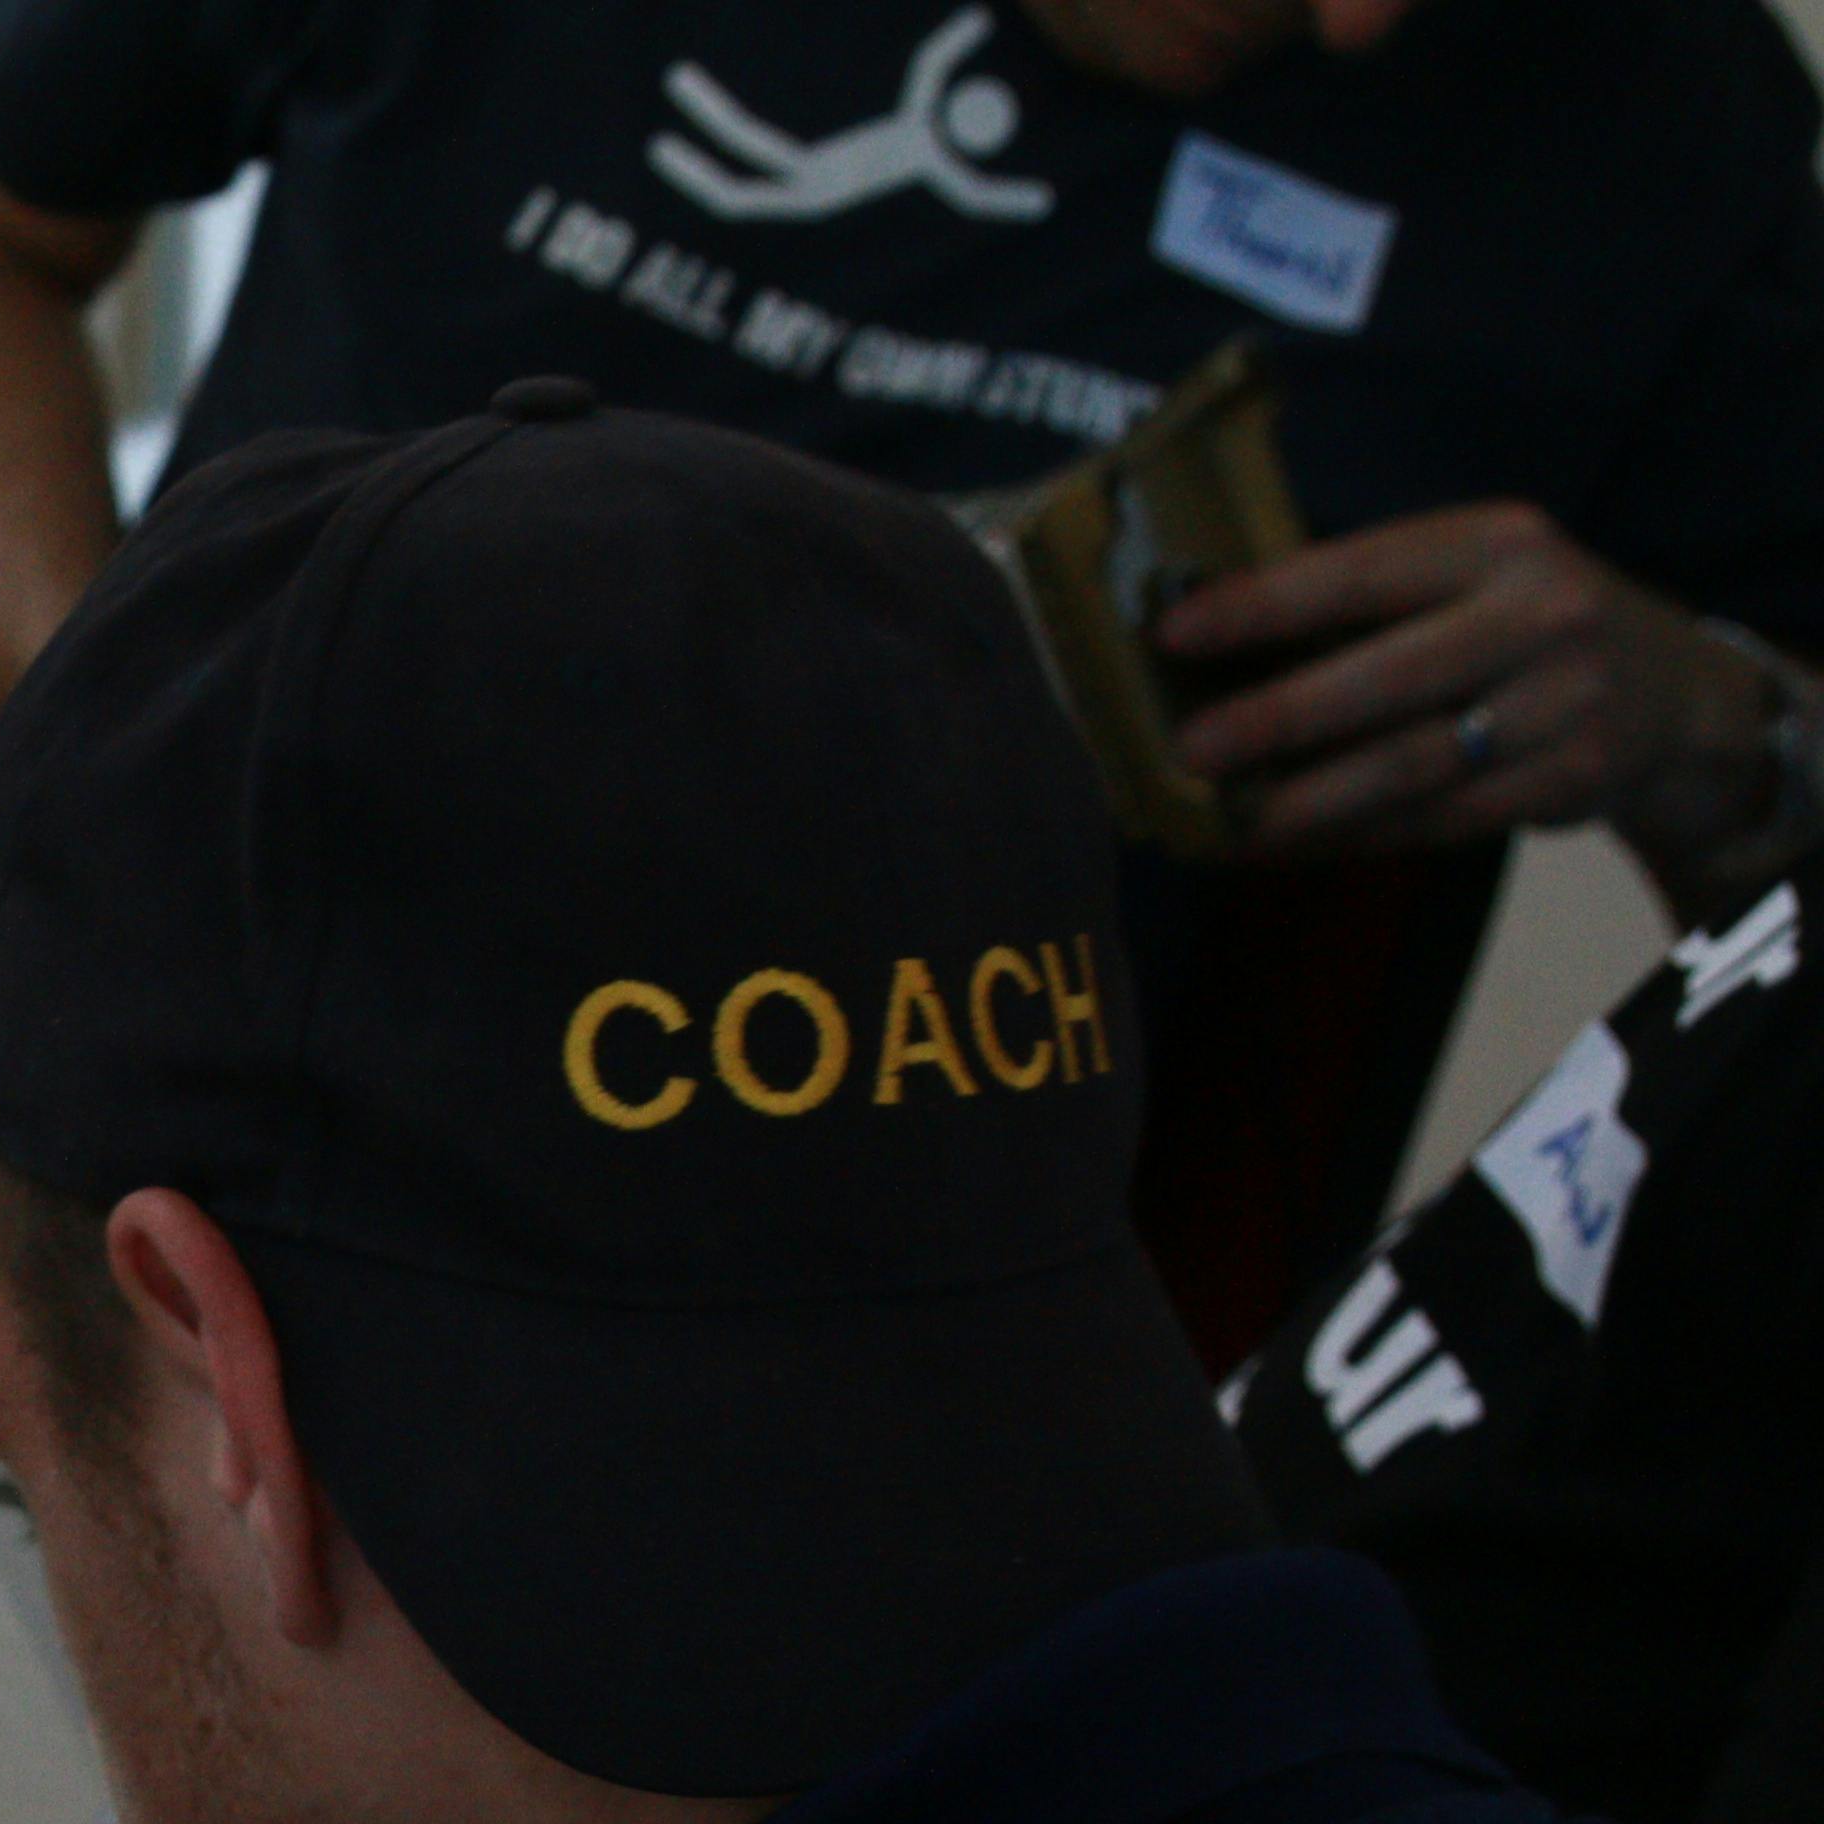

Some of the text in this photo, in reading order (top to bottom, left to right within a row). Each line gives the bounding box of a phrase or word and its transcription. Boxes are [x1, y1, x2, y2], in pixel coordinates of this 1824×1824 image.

[505, 184, 558, 253] I
[539, 199, 638, 291] DO
[618, 240, 737, 343] ALL
[732, 286, 851, 382] MY
[835, 322, 990, 412] OWN
[561, 931, 1114, 1133] COACH
